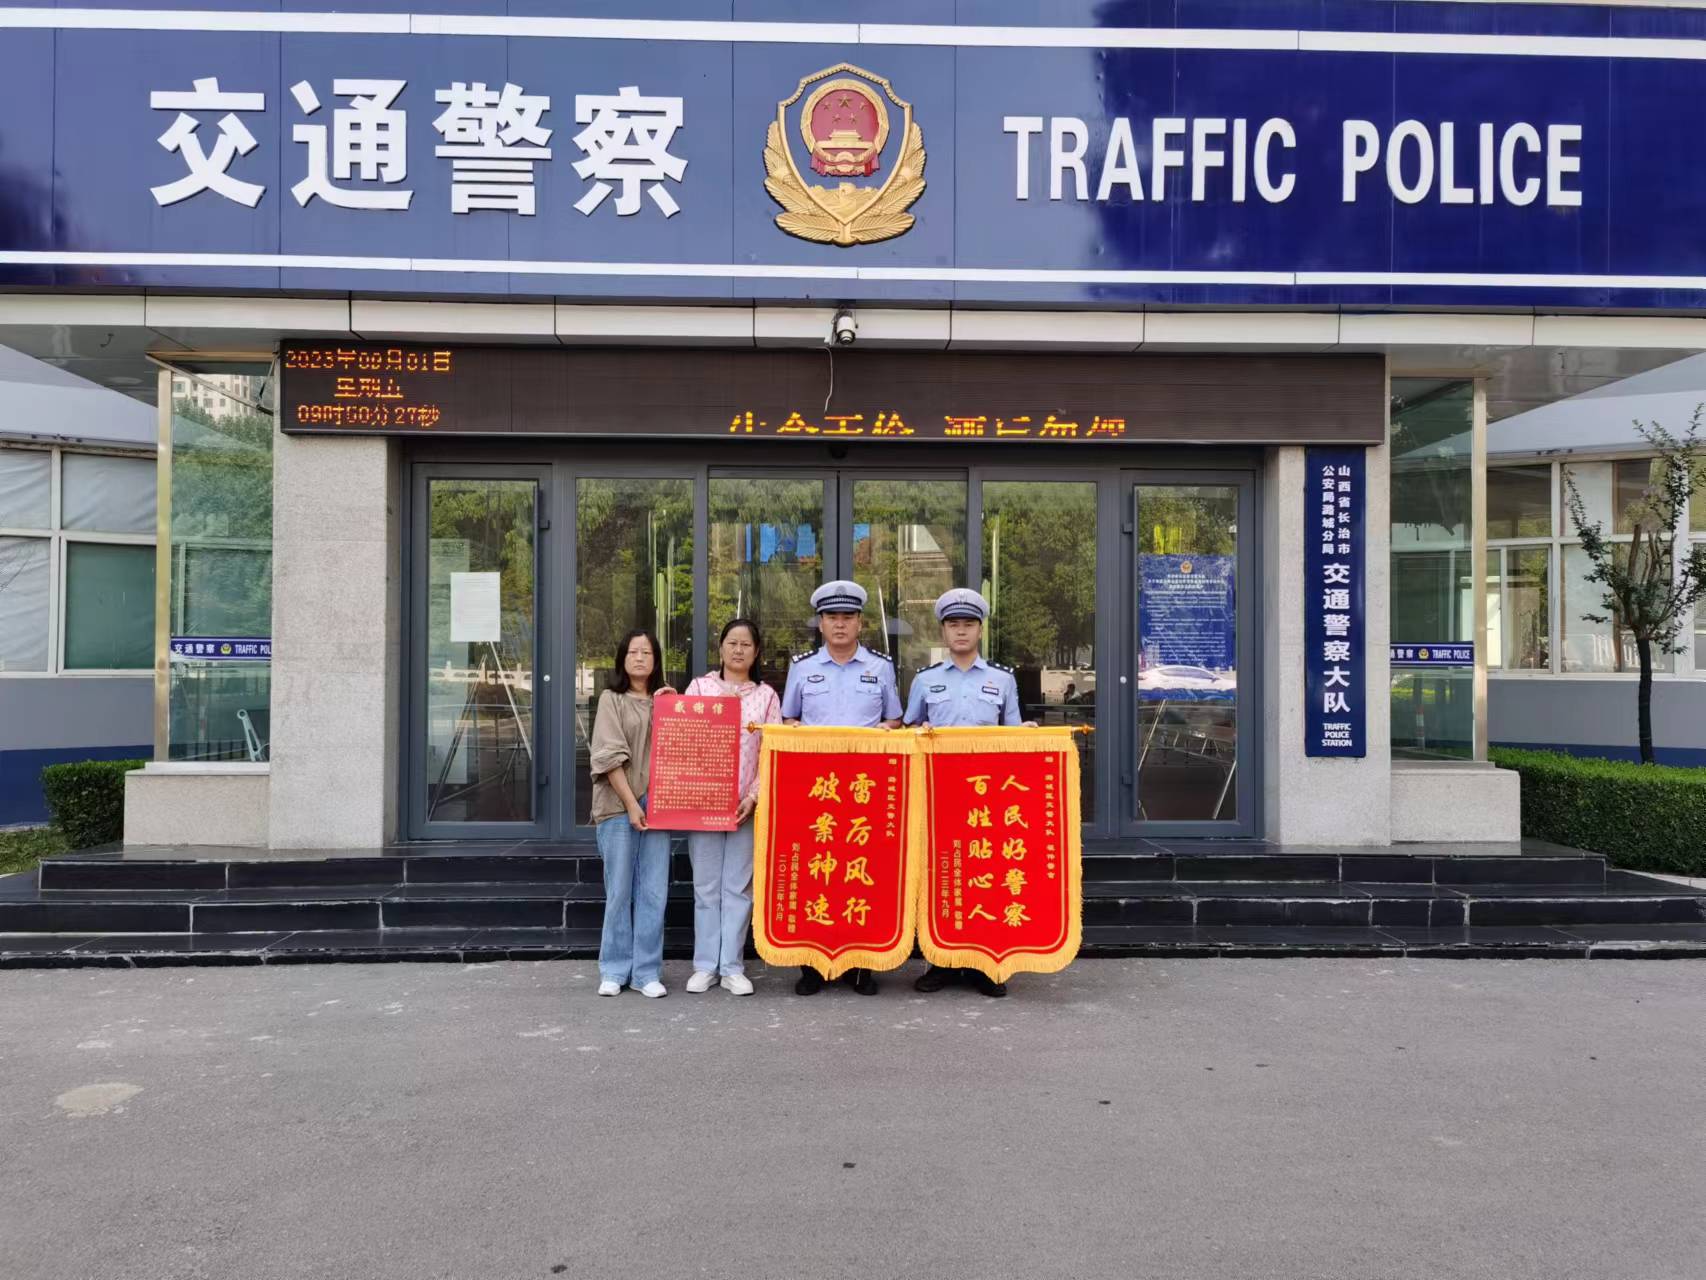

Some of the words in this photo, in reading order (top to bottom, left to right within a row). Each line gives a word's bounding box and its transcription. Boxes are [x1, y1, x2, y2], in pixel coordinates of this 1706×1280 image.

[150, 77, 688, 219] 交通警察
[1003, 116, 1296, 203] TRAFFIC
[1342, 119, 1583, 206] POLICE
[1322, 465, 1335, 555] 公安局潞城分局
[1338, 465, 1351, 555] 山西省长治市
[174, 643, 215, 654] 交通警察
[235, 644, 258, 654] TRAFFIC
[1323, 562, 1351, 713] 交通警察大队
[1432, 649, 1452, 659] TRAFFIC
[1453, 649, 1470, 659] POLICE
[1321, 739, 1352, 747] STATION
[1323, 723, 1351, 731] TRAFFIC
[1324, 731, 1349, 739] POLICE
[804, 771, 842, 926] 破案神速
[842, 773, 877, 927] 雷厉风行
[966, 775, 997, 921] 百姓贴心人
[1001, 774, 1032, 927] 人民好警察
